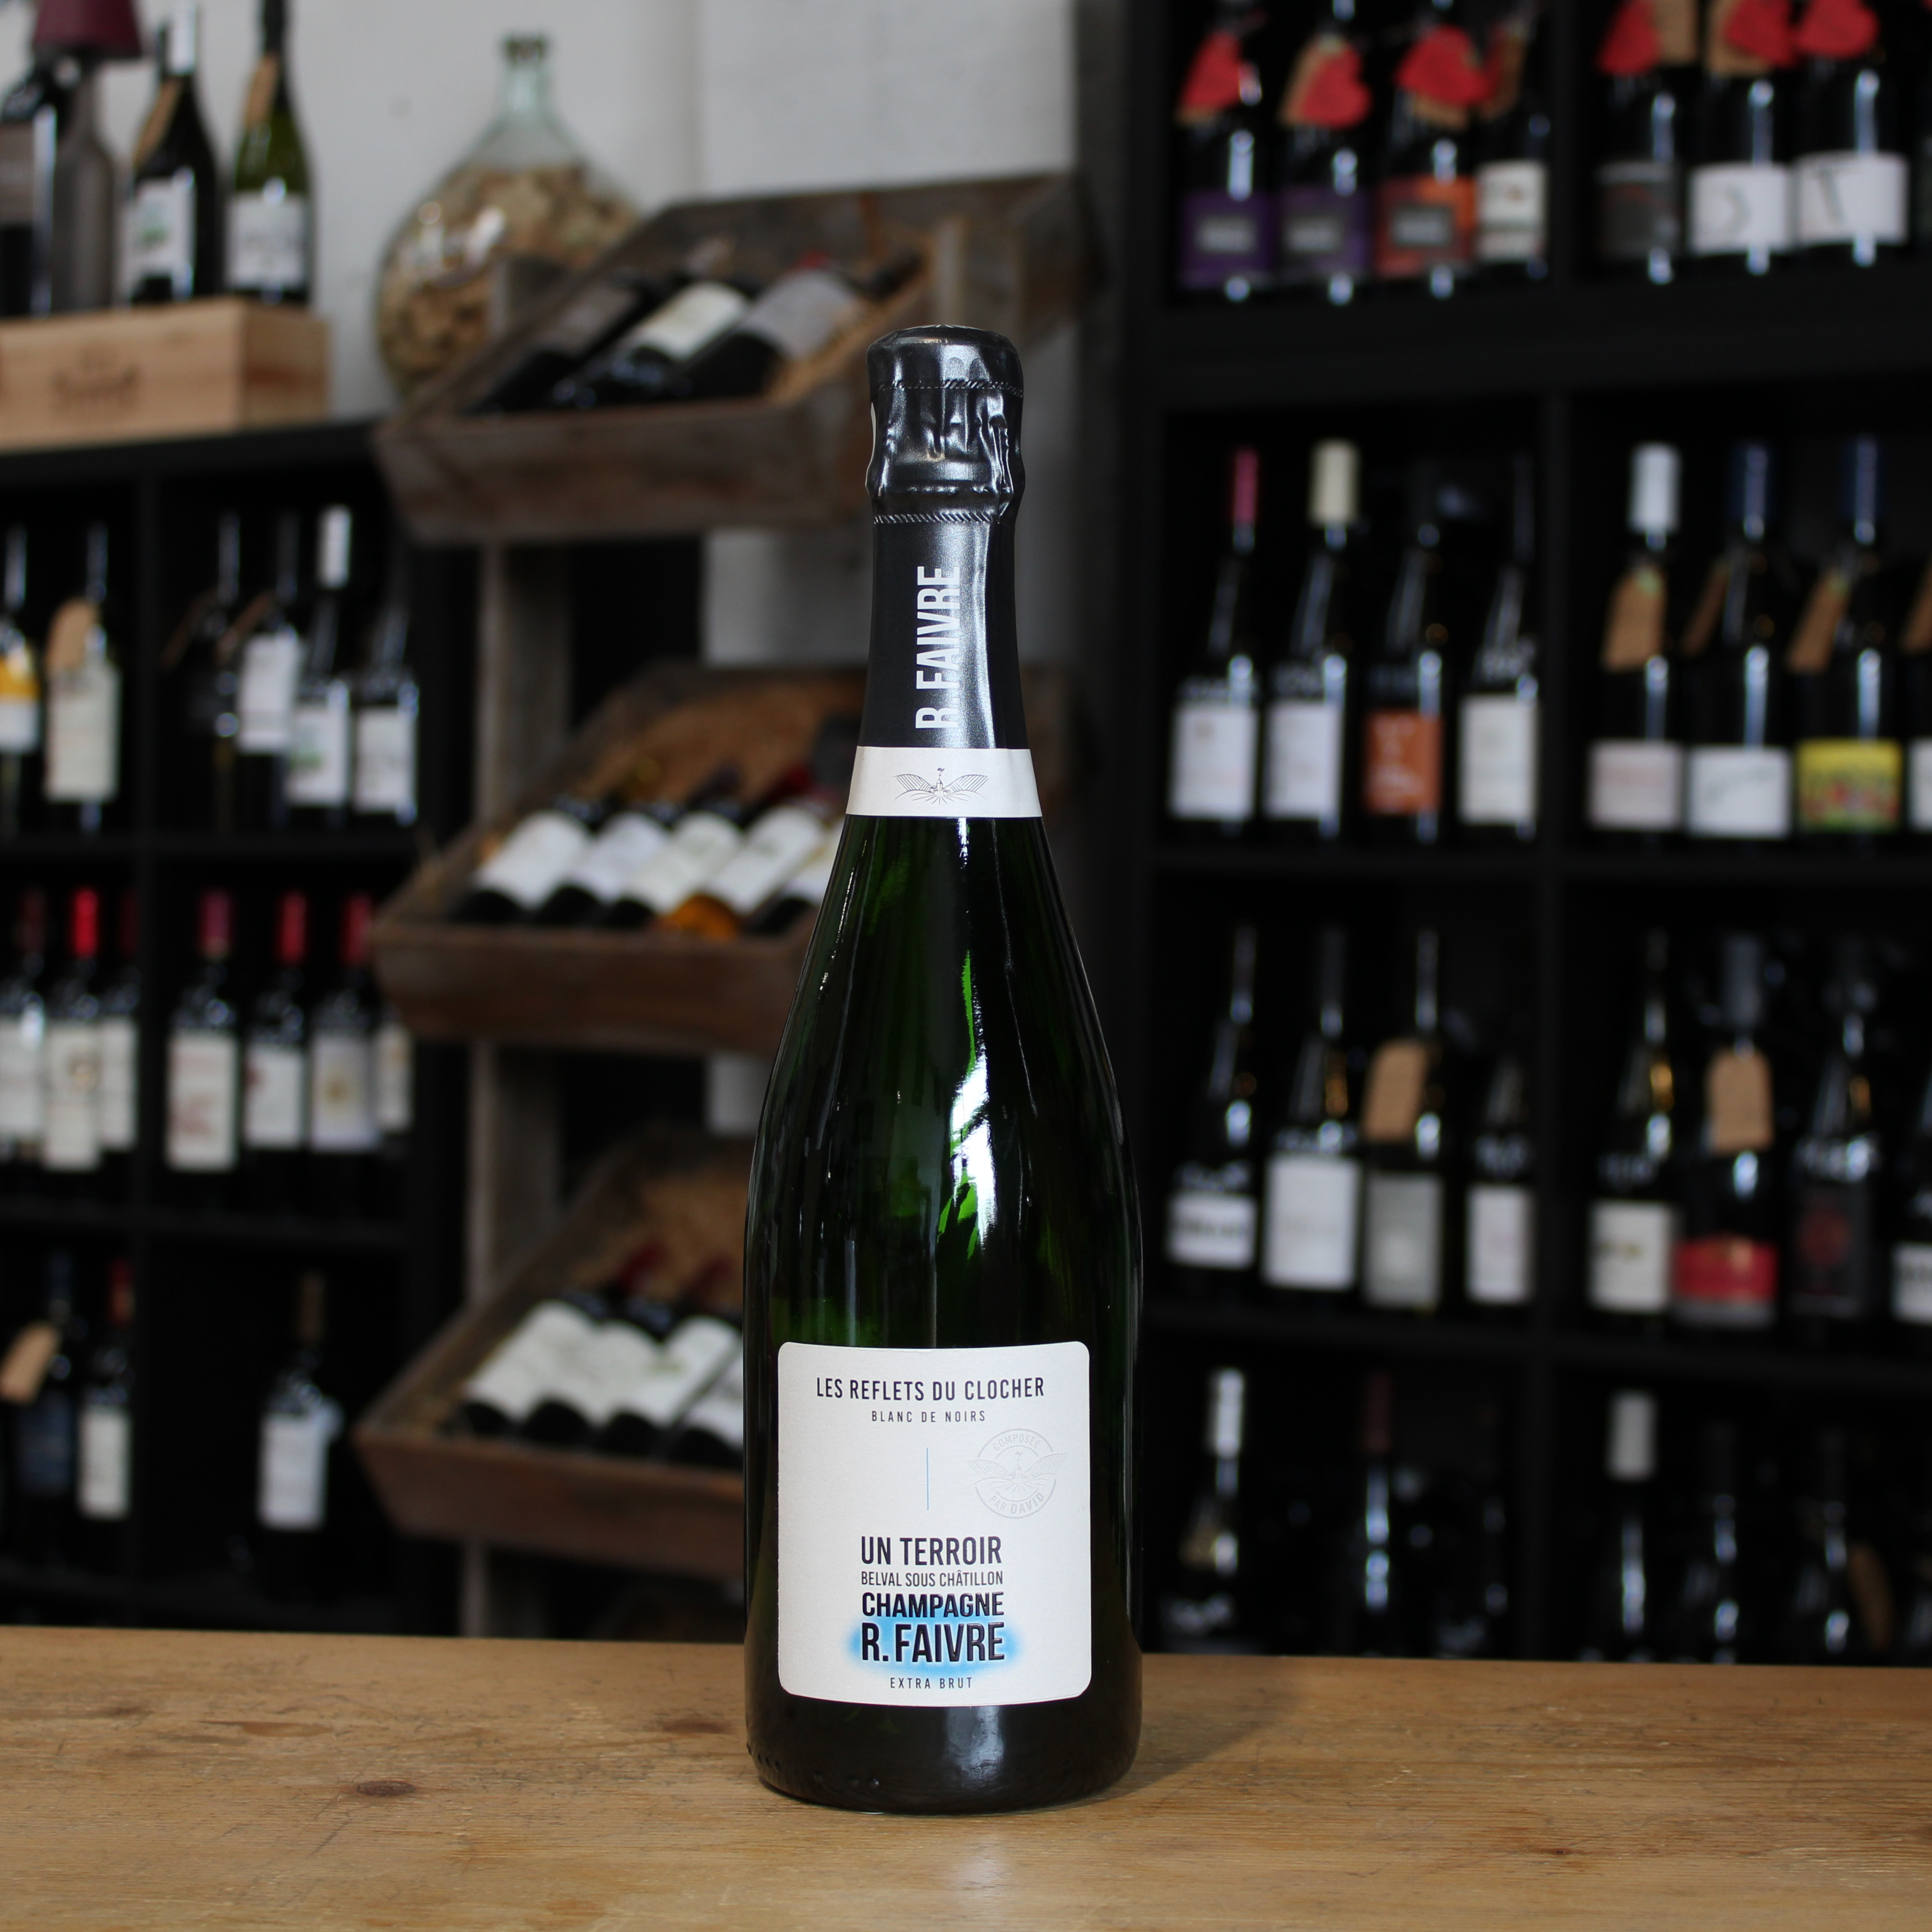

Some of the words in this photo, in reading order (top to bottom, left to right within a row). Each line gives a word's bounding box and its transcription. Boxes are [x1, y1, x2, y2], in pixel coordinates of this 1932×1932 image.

[817, 1377, 843, 1398] LES
[850, 1380, 924, 1401] REFLETS
[933, 1382, 955, 1401] DU
[965, 1377, 1044, 1400] CLOCHER
[872, 1410, 912, 1422] BLANC
[921, 1411, 935, 1422] DE
[946, 1410, 985, 1422] NOIRS
[989, 1495, 1007, 1512] PAR
[1010, 1492, 1044, 1514] DAVID
[861, 1536, 891, 1565] UN
[899, 1536, 1002, 1566] TERROIR
[861, 1571, 902, 1586] BELVAL
[906, 1572, 935, 1587] SOUS
[940, 1570, 1003, 1587] CHÂTILLON
[862, 1592, 1004, 1618] CHAMPAGNE
[890, 1677, 930, 1689] EXTRA
[940, 1677, 972, 1689] BRUT
